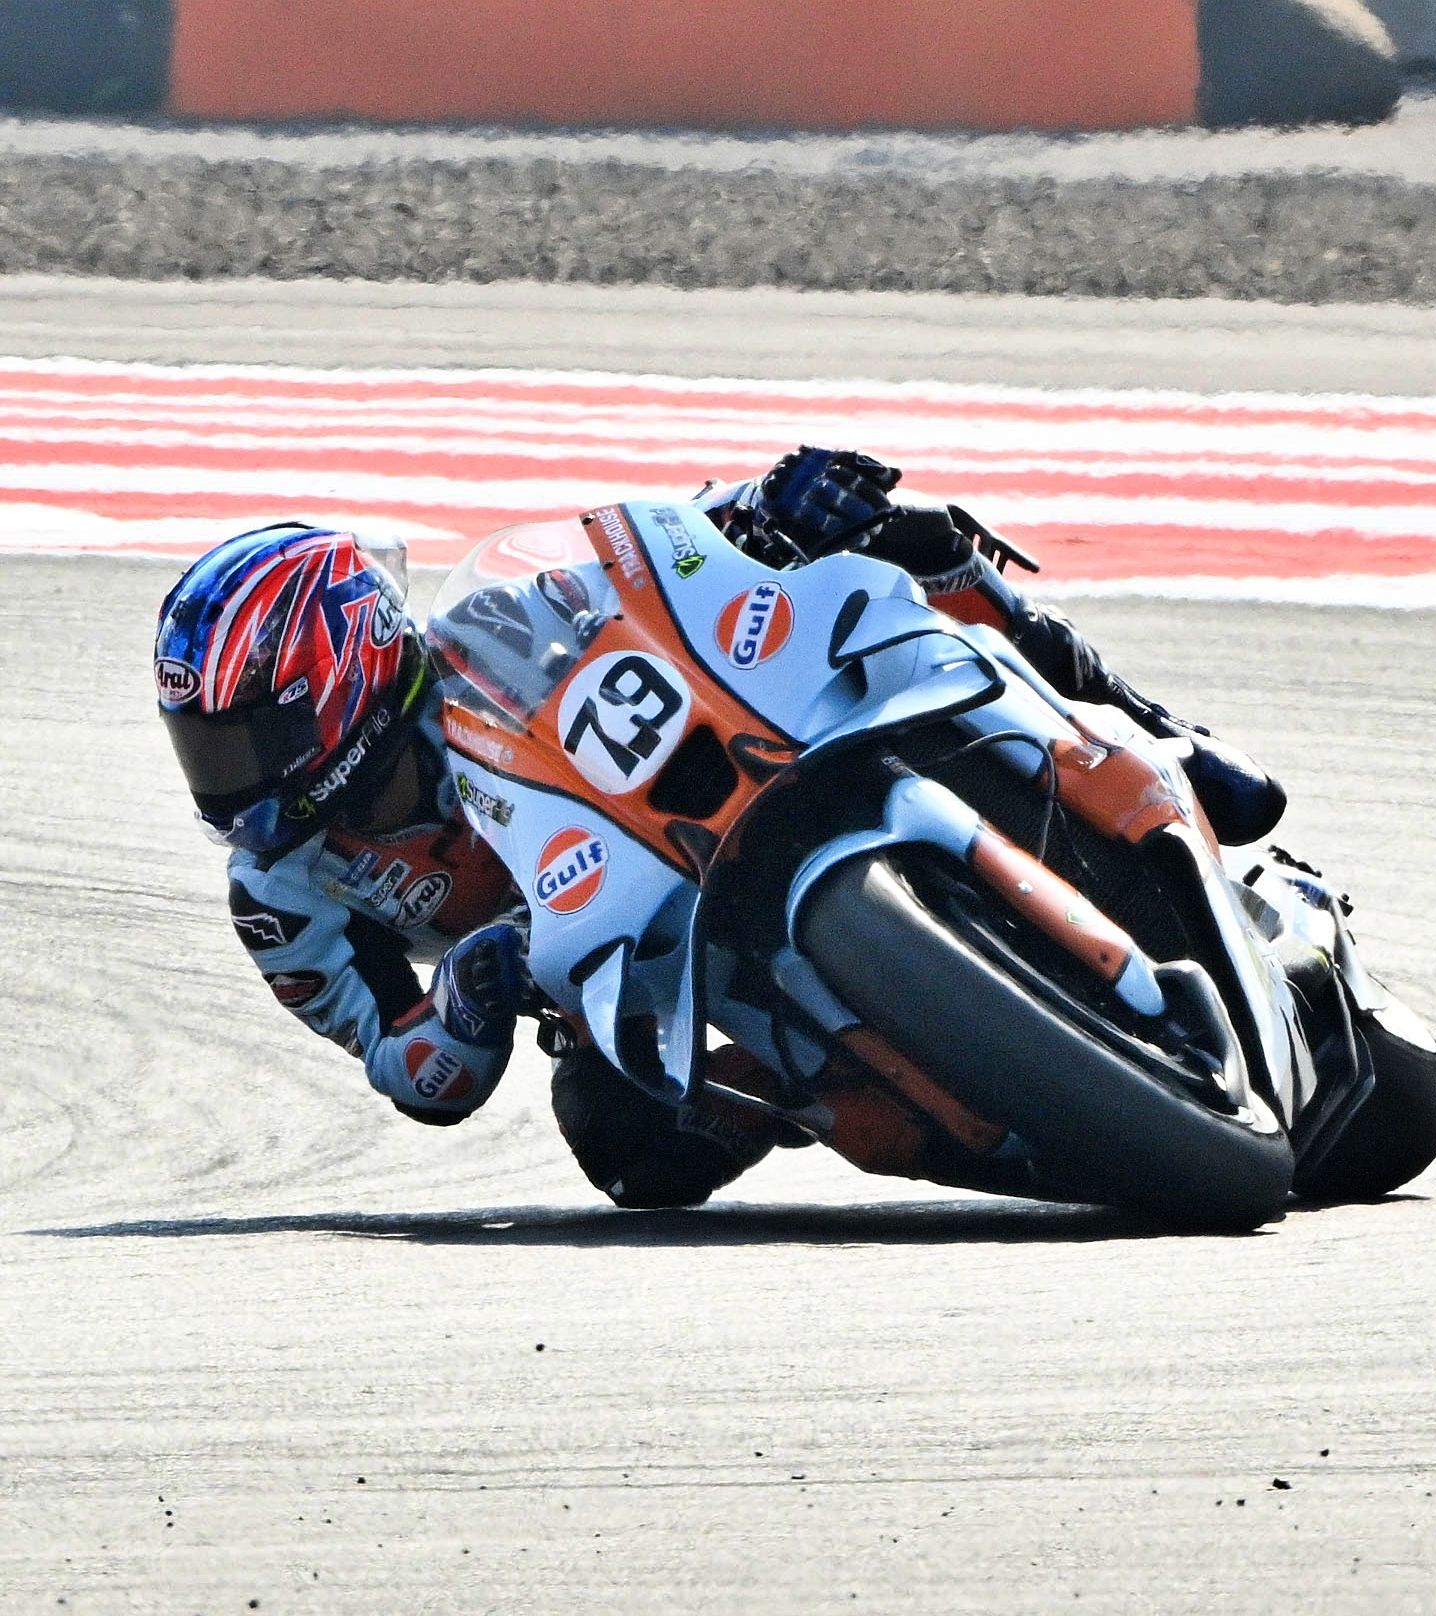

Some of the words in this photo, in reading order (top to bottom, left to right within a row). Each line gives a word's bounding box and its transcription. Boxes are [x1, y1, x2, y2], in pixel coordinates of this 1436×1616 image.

[595, 507, 642, 580] TRACKHOUSE
[733, 585, 776, 665] Gulf
[157, 662, 191, 690] Arai
[563, 655, 685, 780] 79
[536, 839, 604, 900] Gulf
[412, 1053, 461, 1100] Gulf
